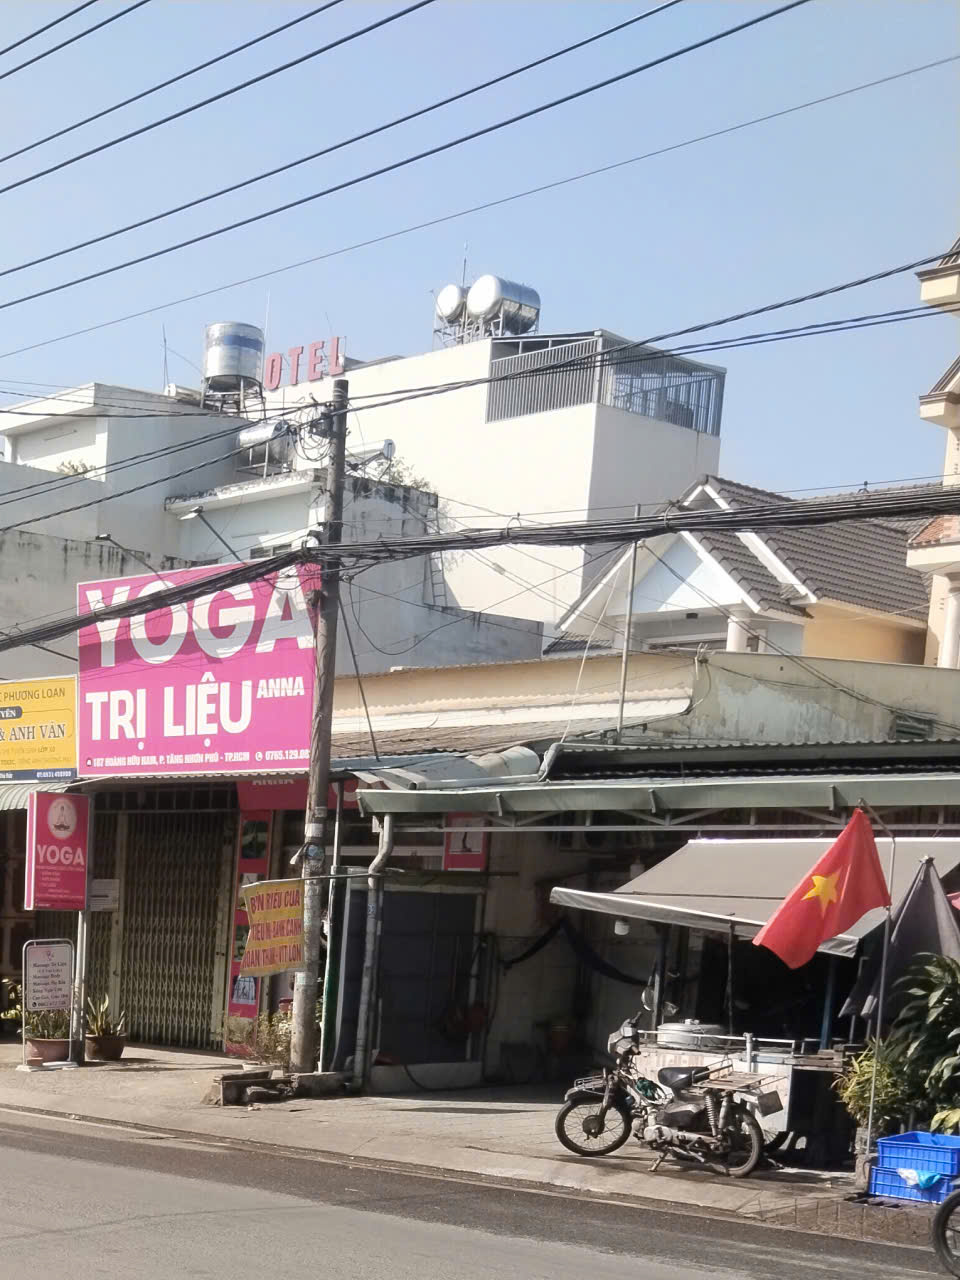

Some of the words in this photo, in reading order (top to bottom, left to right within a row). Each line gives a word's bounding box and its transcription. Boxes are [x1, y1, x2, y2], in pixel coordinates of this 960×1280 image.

[265, 336, 344, 390] OTEL
[85, 563, 317, 667] YOGA
[3, 690, 40, 703] PHƯƠNG
[42, 688, 66, 699] LOAN
[256, 676, 304, 699] ANNA
[85, 688, 146, 750] TRỊ
[164, 671, 252, 747] LIỆU
[9, 725, 36, 741] ANH
[40, 722, 66, 739] VĂN
[36, 845, 85, 866] YOGA
[284, 889, 300, 907] CUA
